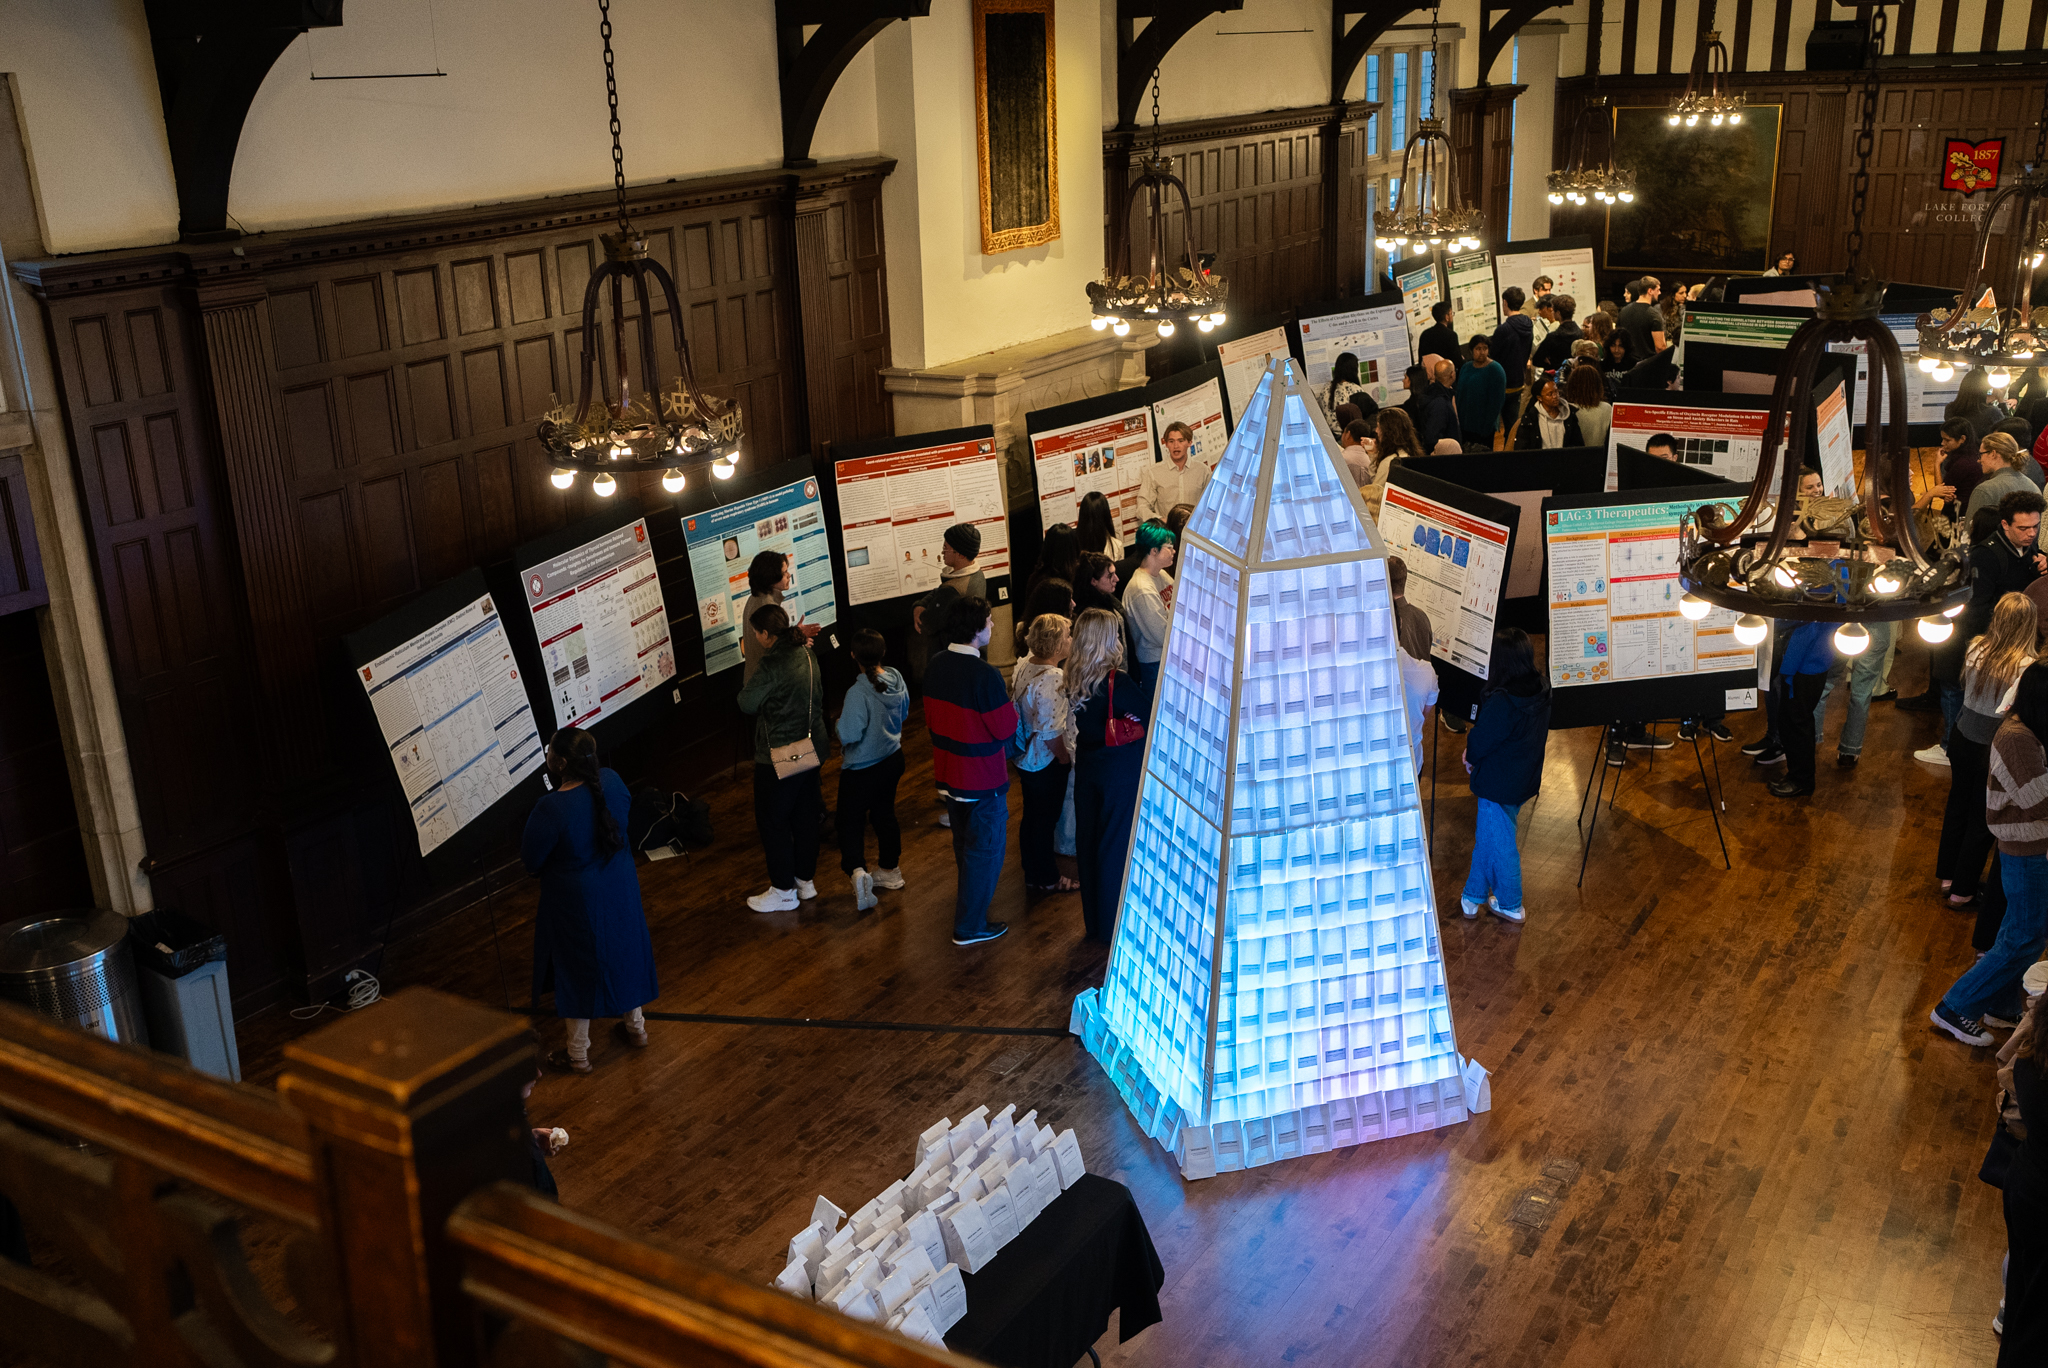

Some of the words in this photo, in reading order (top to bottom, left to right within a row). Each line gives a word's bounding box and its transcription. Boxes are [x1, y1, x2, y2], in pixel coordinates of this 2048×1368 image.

[1974, 150, 1998, 160] 1857
[1560, 510, 1592, 522] LAG-3
[1595, 506, 1669, 519] Therapeutics:
[547, 567, 566, 578] Compounds
[621, 537, 632, 546] System
[552, 558, 568, 568] Molecular
[569, 551, 584, 561] Dynamics
[374, 653, 396, 668] Endoplasmic
[395, 644, 410, 656] Reticulum
[409, 635, 425, 647] Membrane
[425, 630, 435, 638] Protein
[435, 622, 447, 632] Complex
[455, 611, 466, 620] Distinct
[416, 639, 431, 650] Individual
[431, 632, 443, 642] Subunits
[1745, 691, 1752, 700] A
